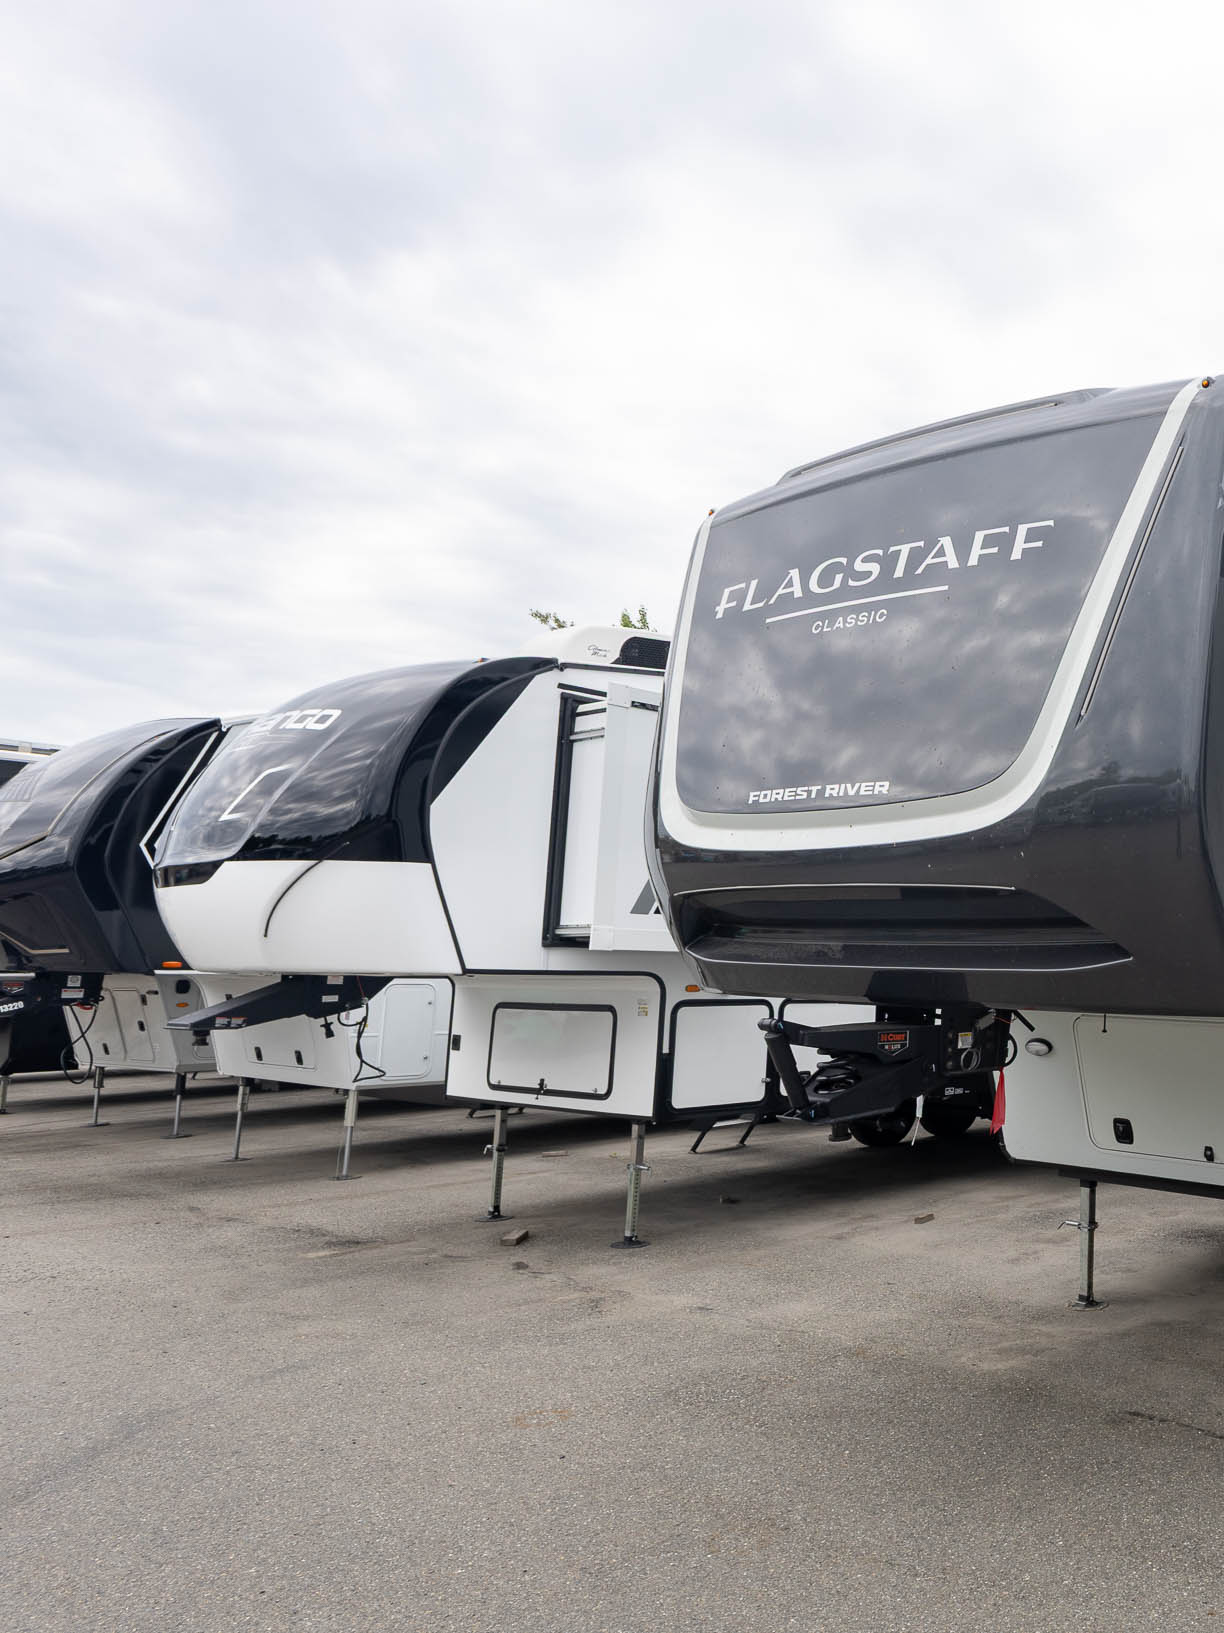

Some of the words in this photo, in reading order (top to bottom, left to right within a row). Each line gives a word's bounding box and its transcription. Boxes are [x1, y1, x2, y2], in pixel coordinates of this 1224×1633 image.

[715, 519, 1055, 620] FLAGSTAFF
[811, 609, 888, 634] CLASSIC
[748, 785, 822, 804] FOREST
[824, 780, 890, 798] RIVER
